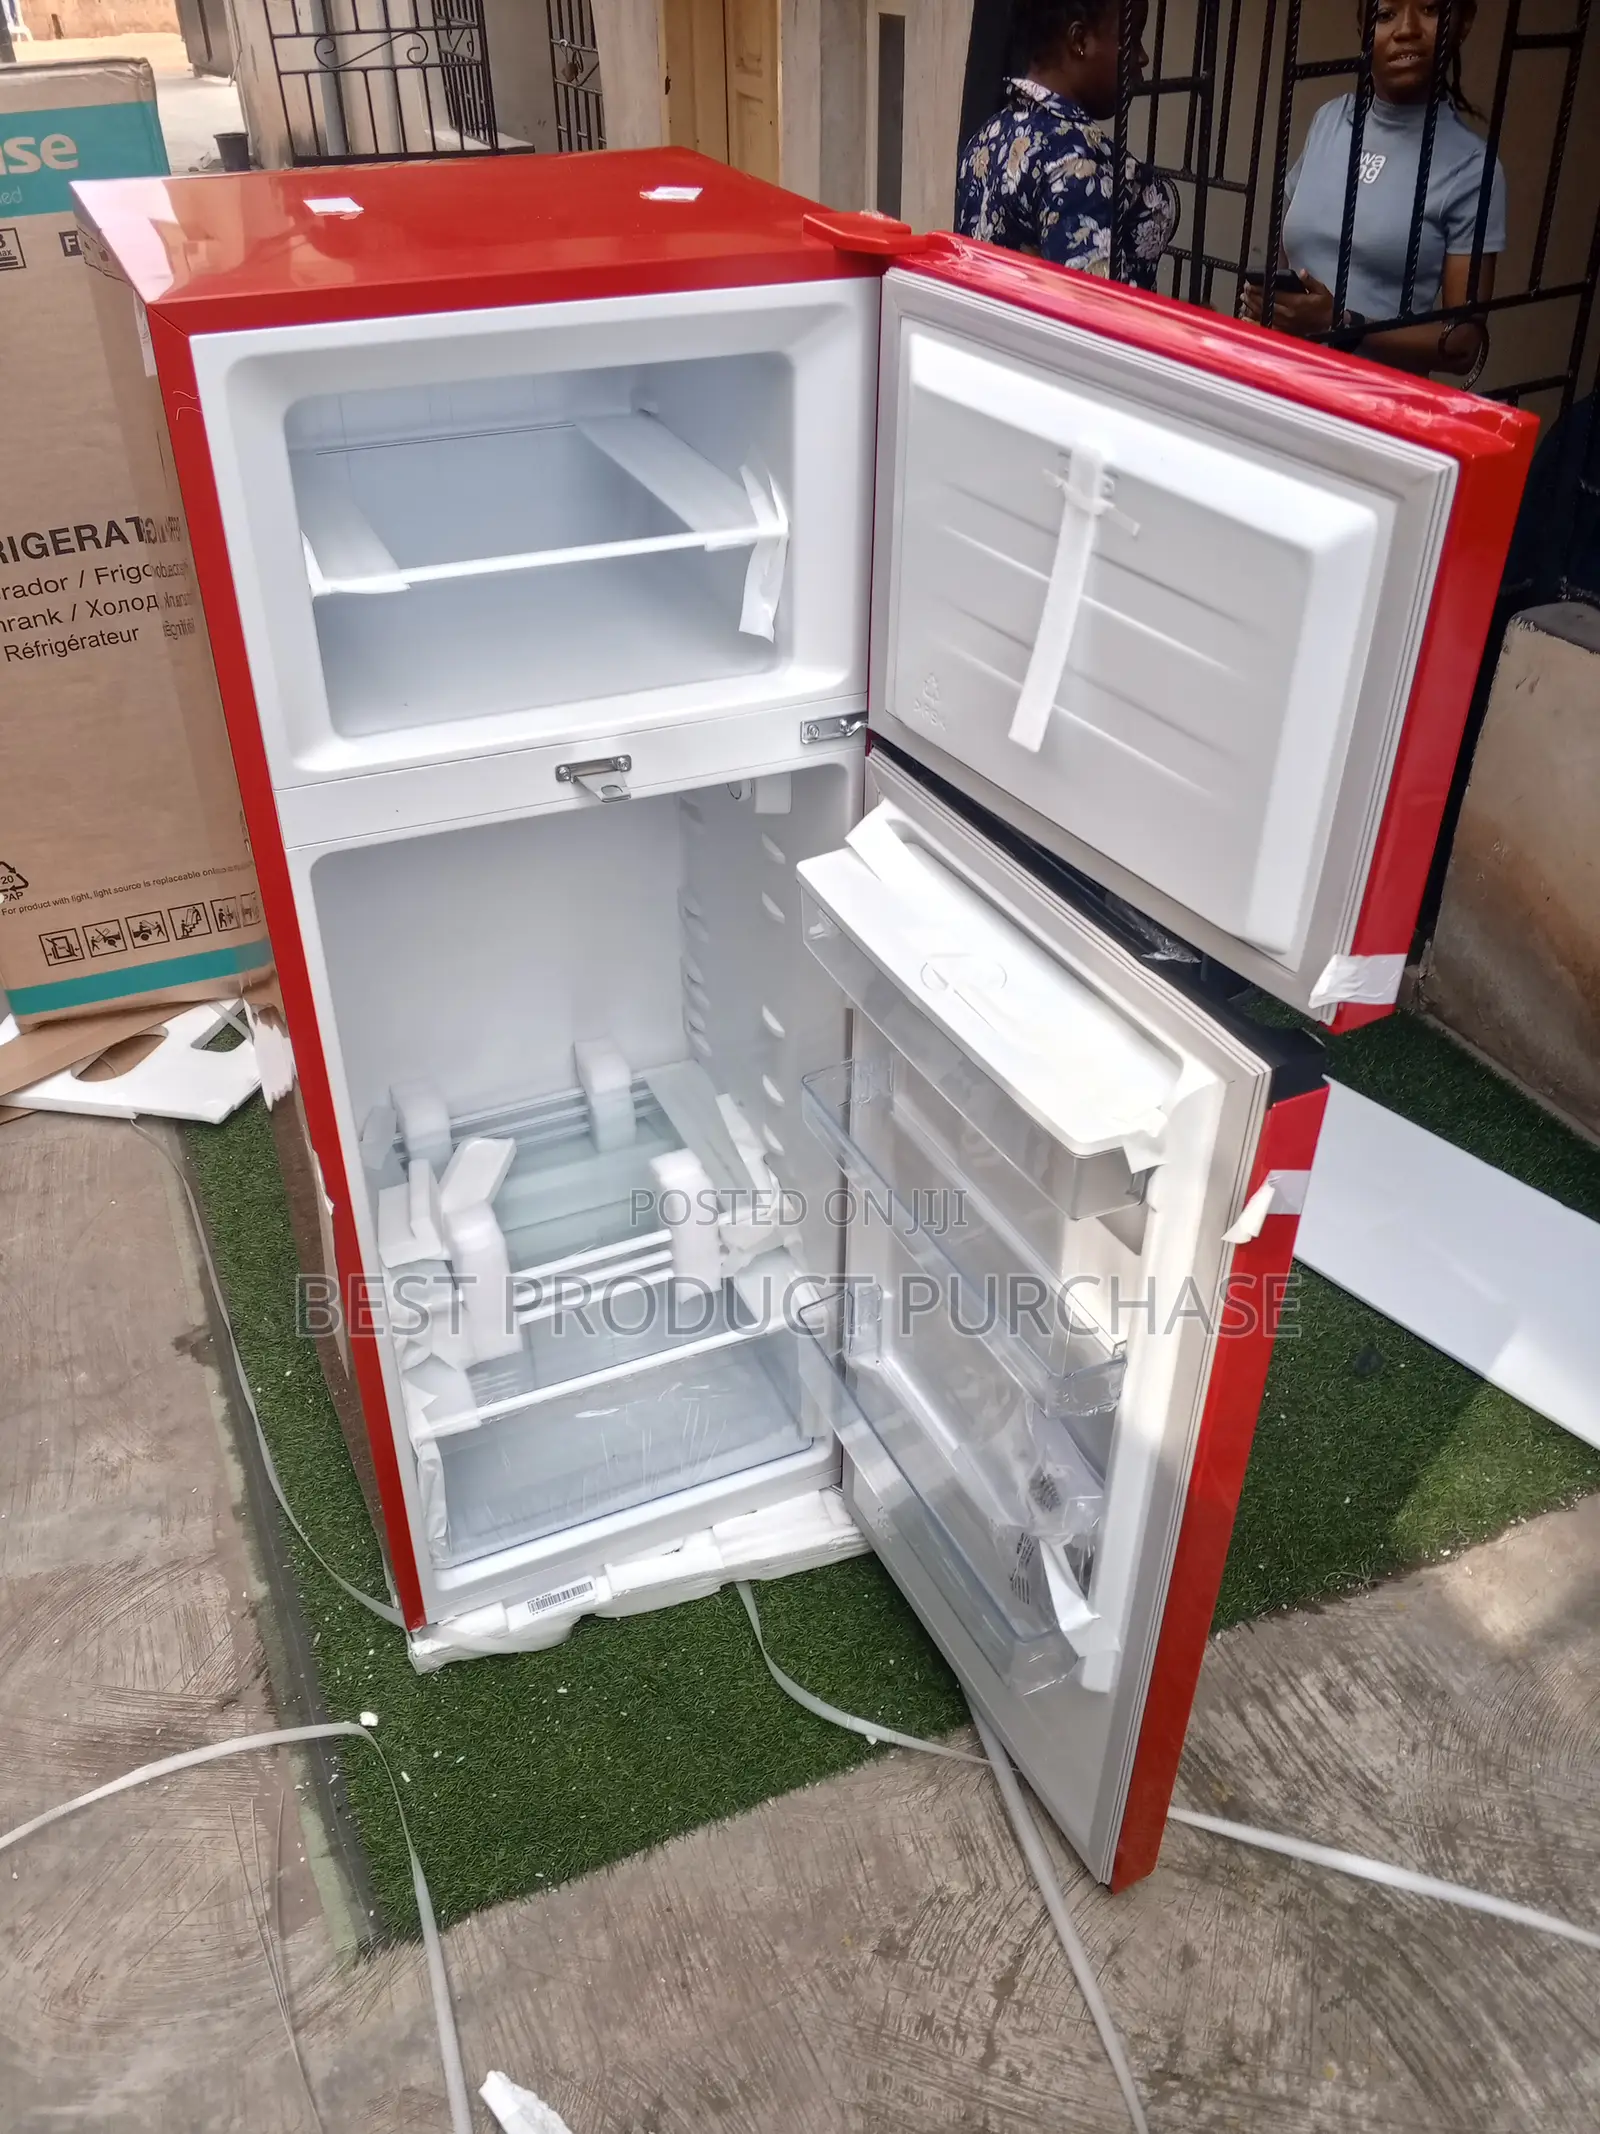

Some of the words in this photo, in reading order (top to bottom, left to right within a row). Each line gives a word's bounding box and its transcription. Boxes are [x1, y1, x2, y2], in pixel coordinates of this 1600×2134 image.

[0, 186, 22, 204] ed
[0, 576, 68, 600] rador
[4, 627, 139, 662] Réfrigérateur
[1, 875, 14, 885] 20
[1, 907, 16, 916] For
[19, 900, 51, 914] product
[52, 896, 70, 906] with
[71, 891, 93, 902] light,
[93, 887, 112, 898] light
[113, 883, 141, 894] source
[153, 870, 200, 886] replaceable
